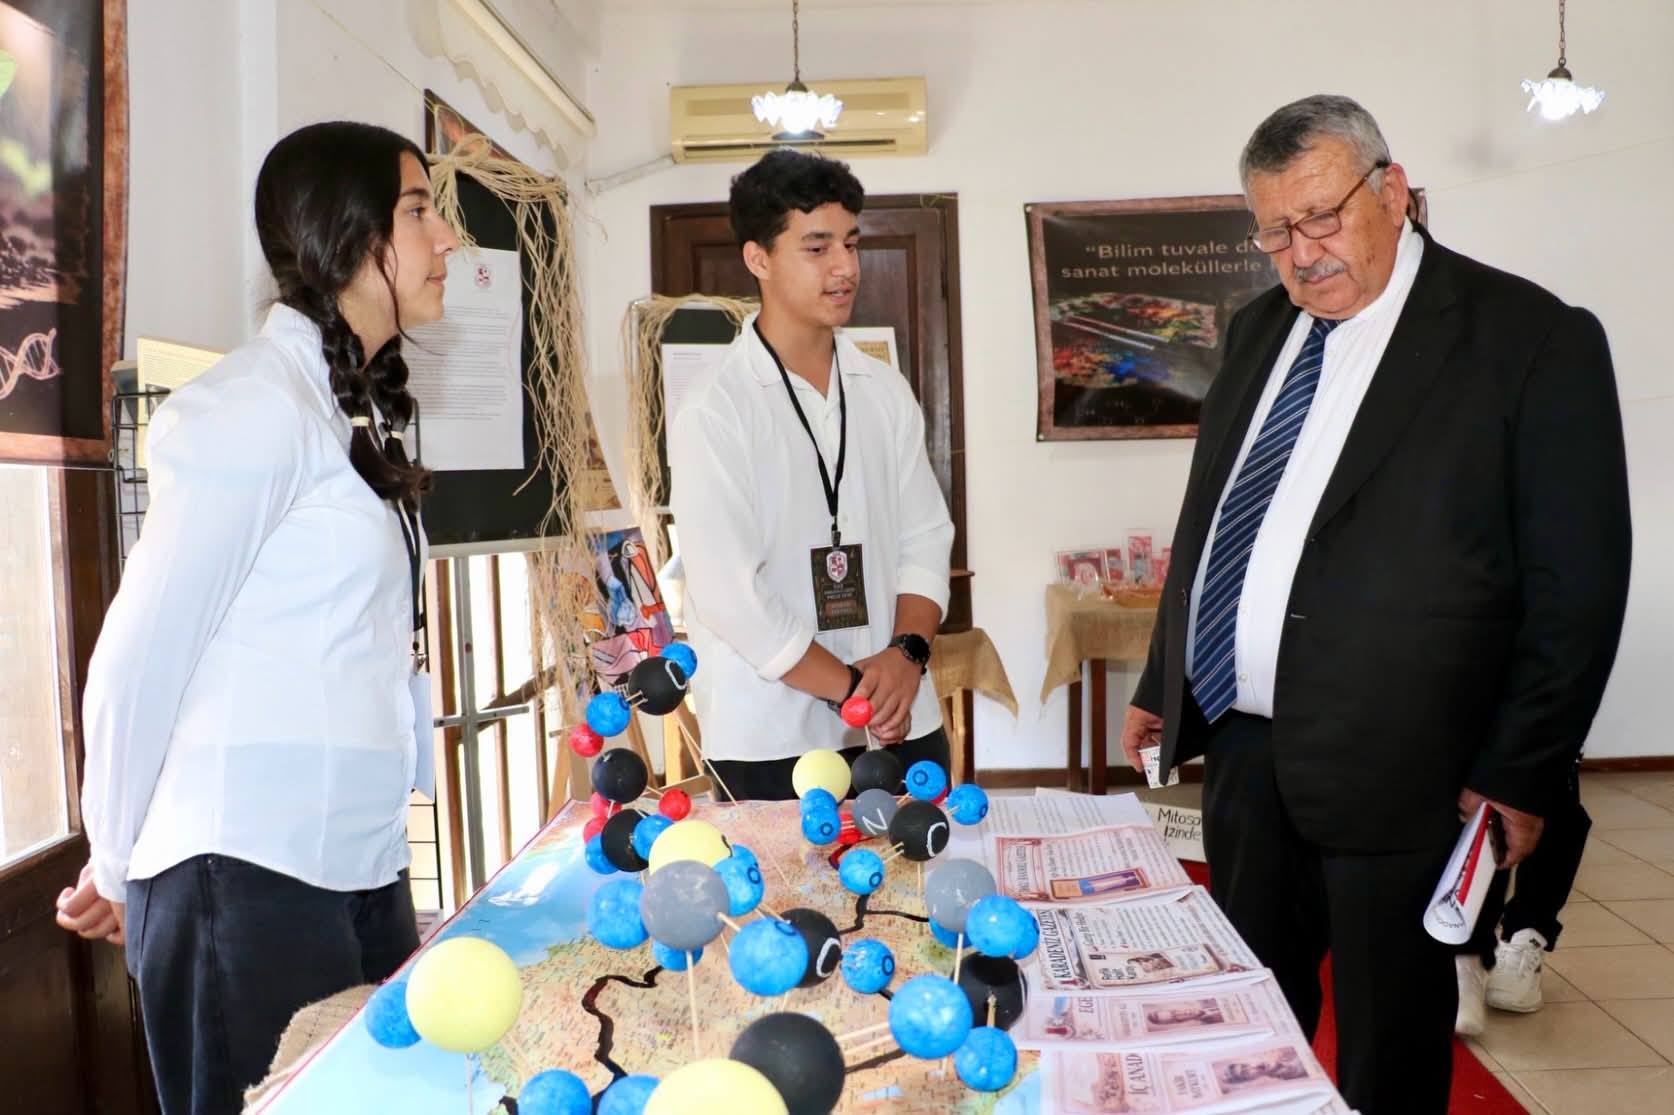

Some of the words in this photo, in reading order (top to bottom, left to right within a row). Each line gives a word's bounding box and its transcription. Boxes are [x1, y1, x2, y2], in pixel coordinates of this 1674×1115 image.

[1162, 240, 1227, 257] tuvale
[1061, 261, 1120, 278] sanat
[1127, 259, 1262, 278] moleküllerle
[1043, 937, 1070, 979] KARADENİZ
